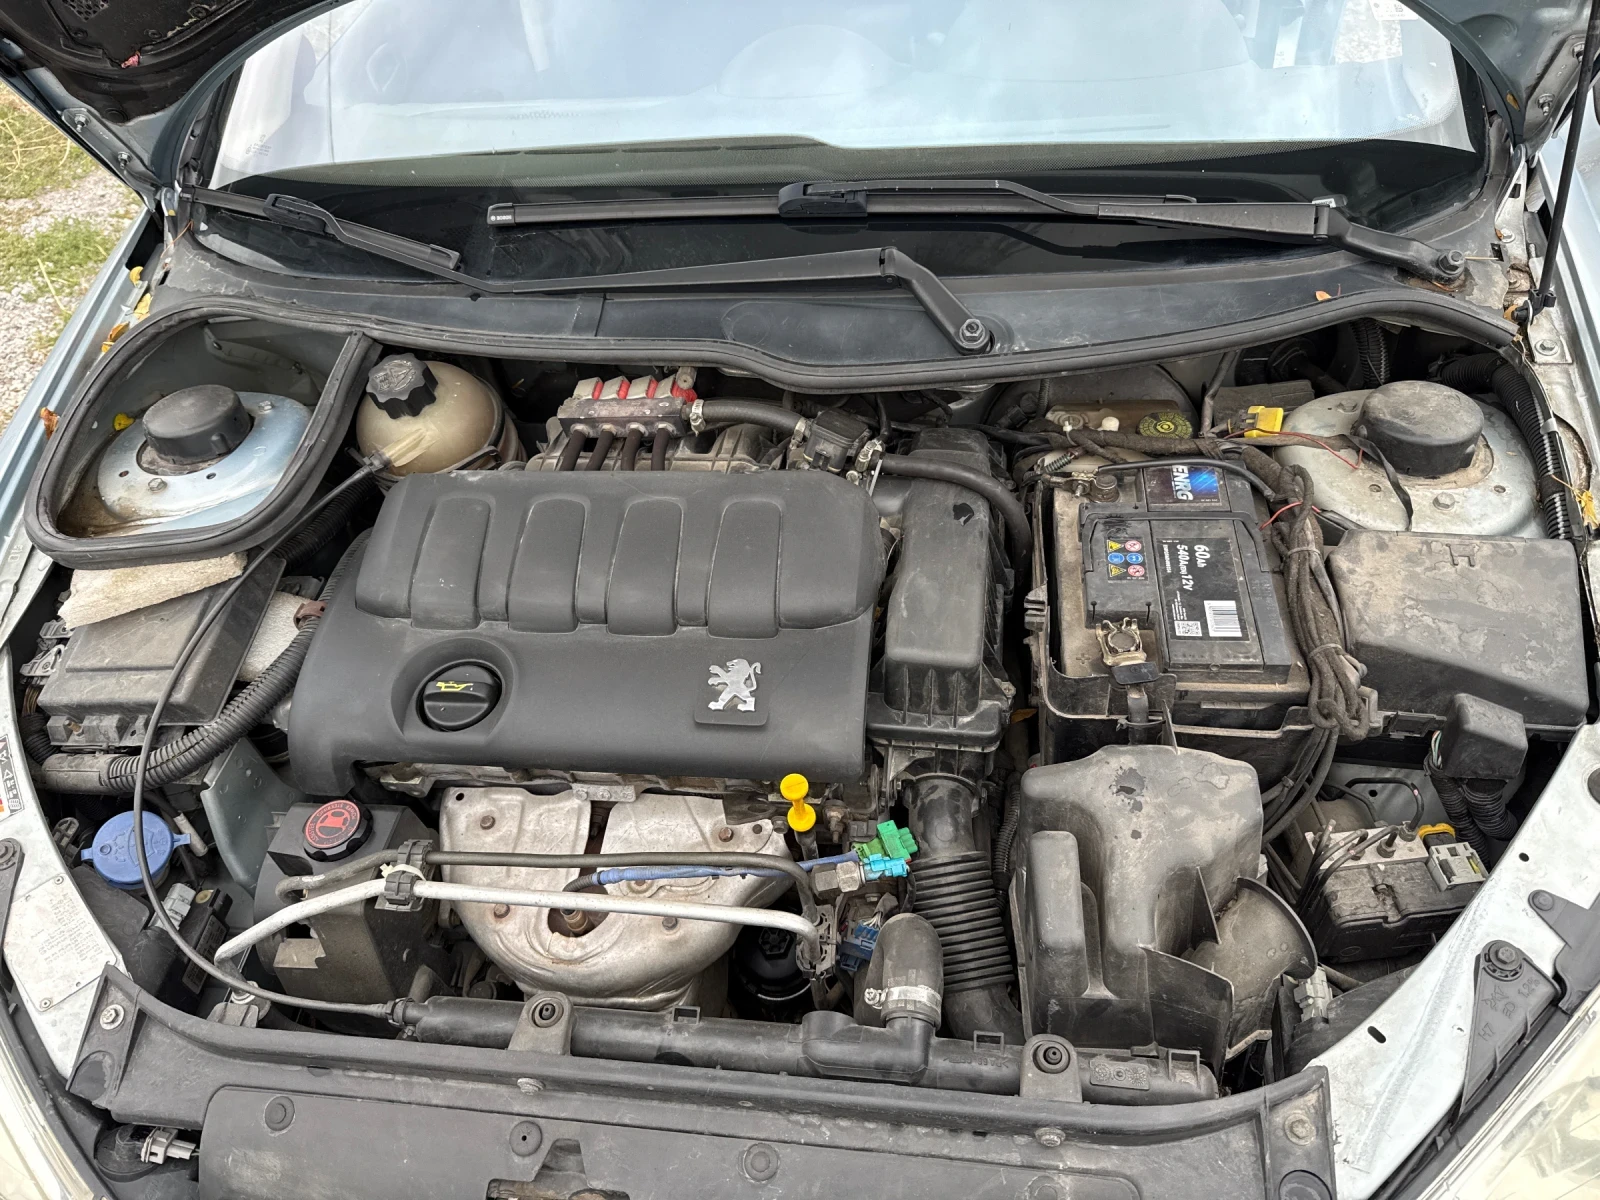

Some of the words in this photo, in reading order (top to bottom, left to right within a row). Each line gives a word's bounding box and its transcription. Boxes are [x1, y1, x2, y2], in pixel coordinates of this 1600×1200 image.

[1171, 465, 1194, 501] ENRG
[1193, 544, 1211, 568] 60Ah
[1181, 574, 1194, 591] 12V
[1478, 1022, 1495, 1042] H7
